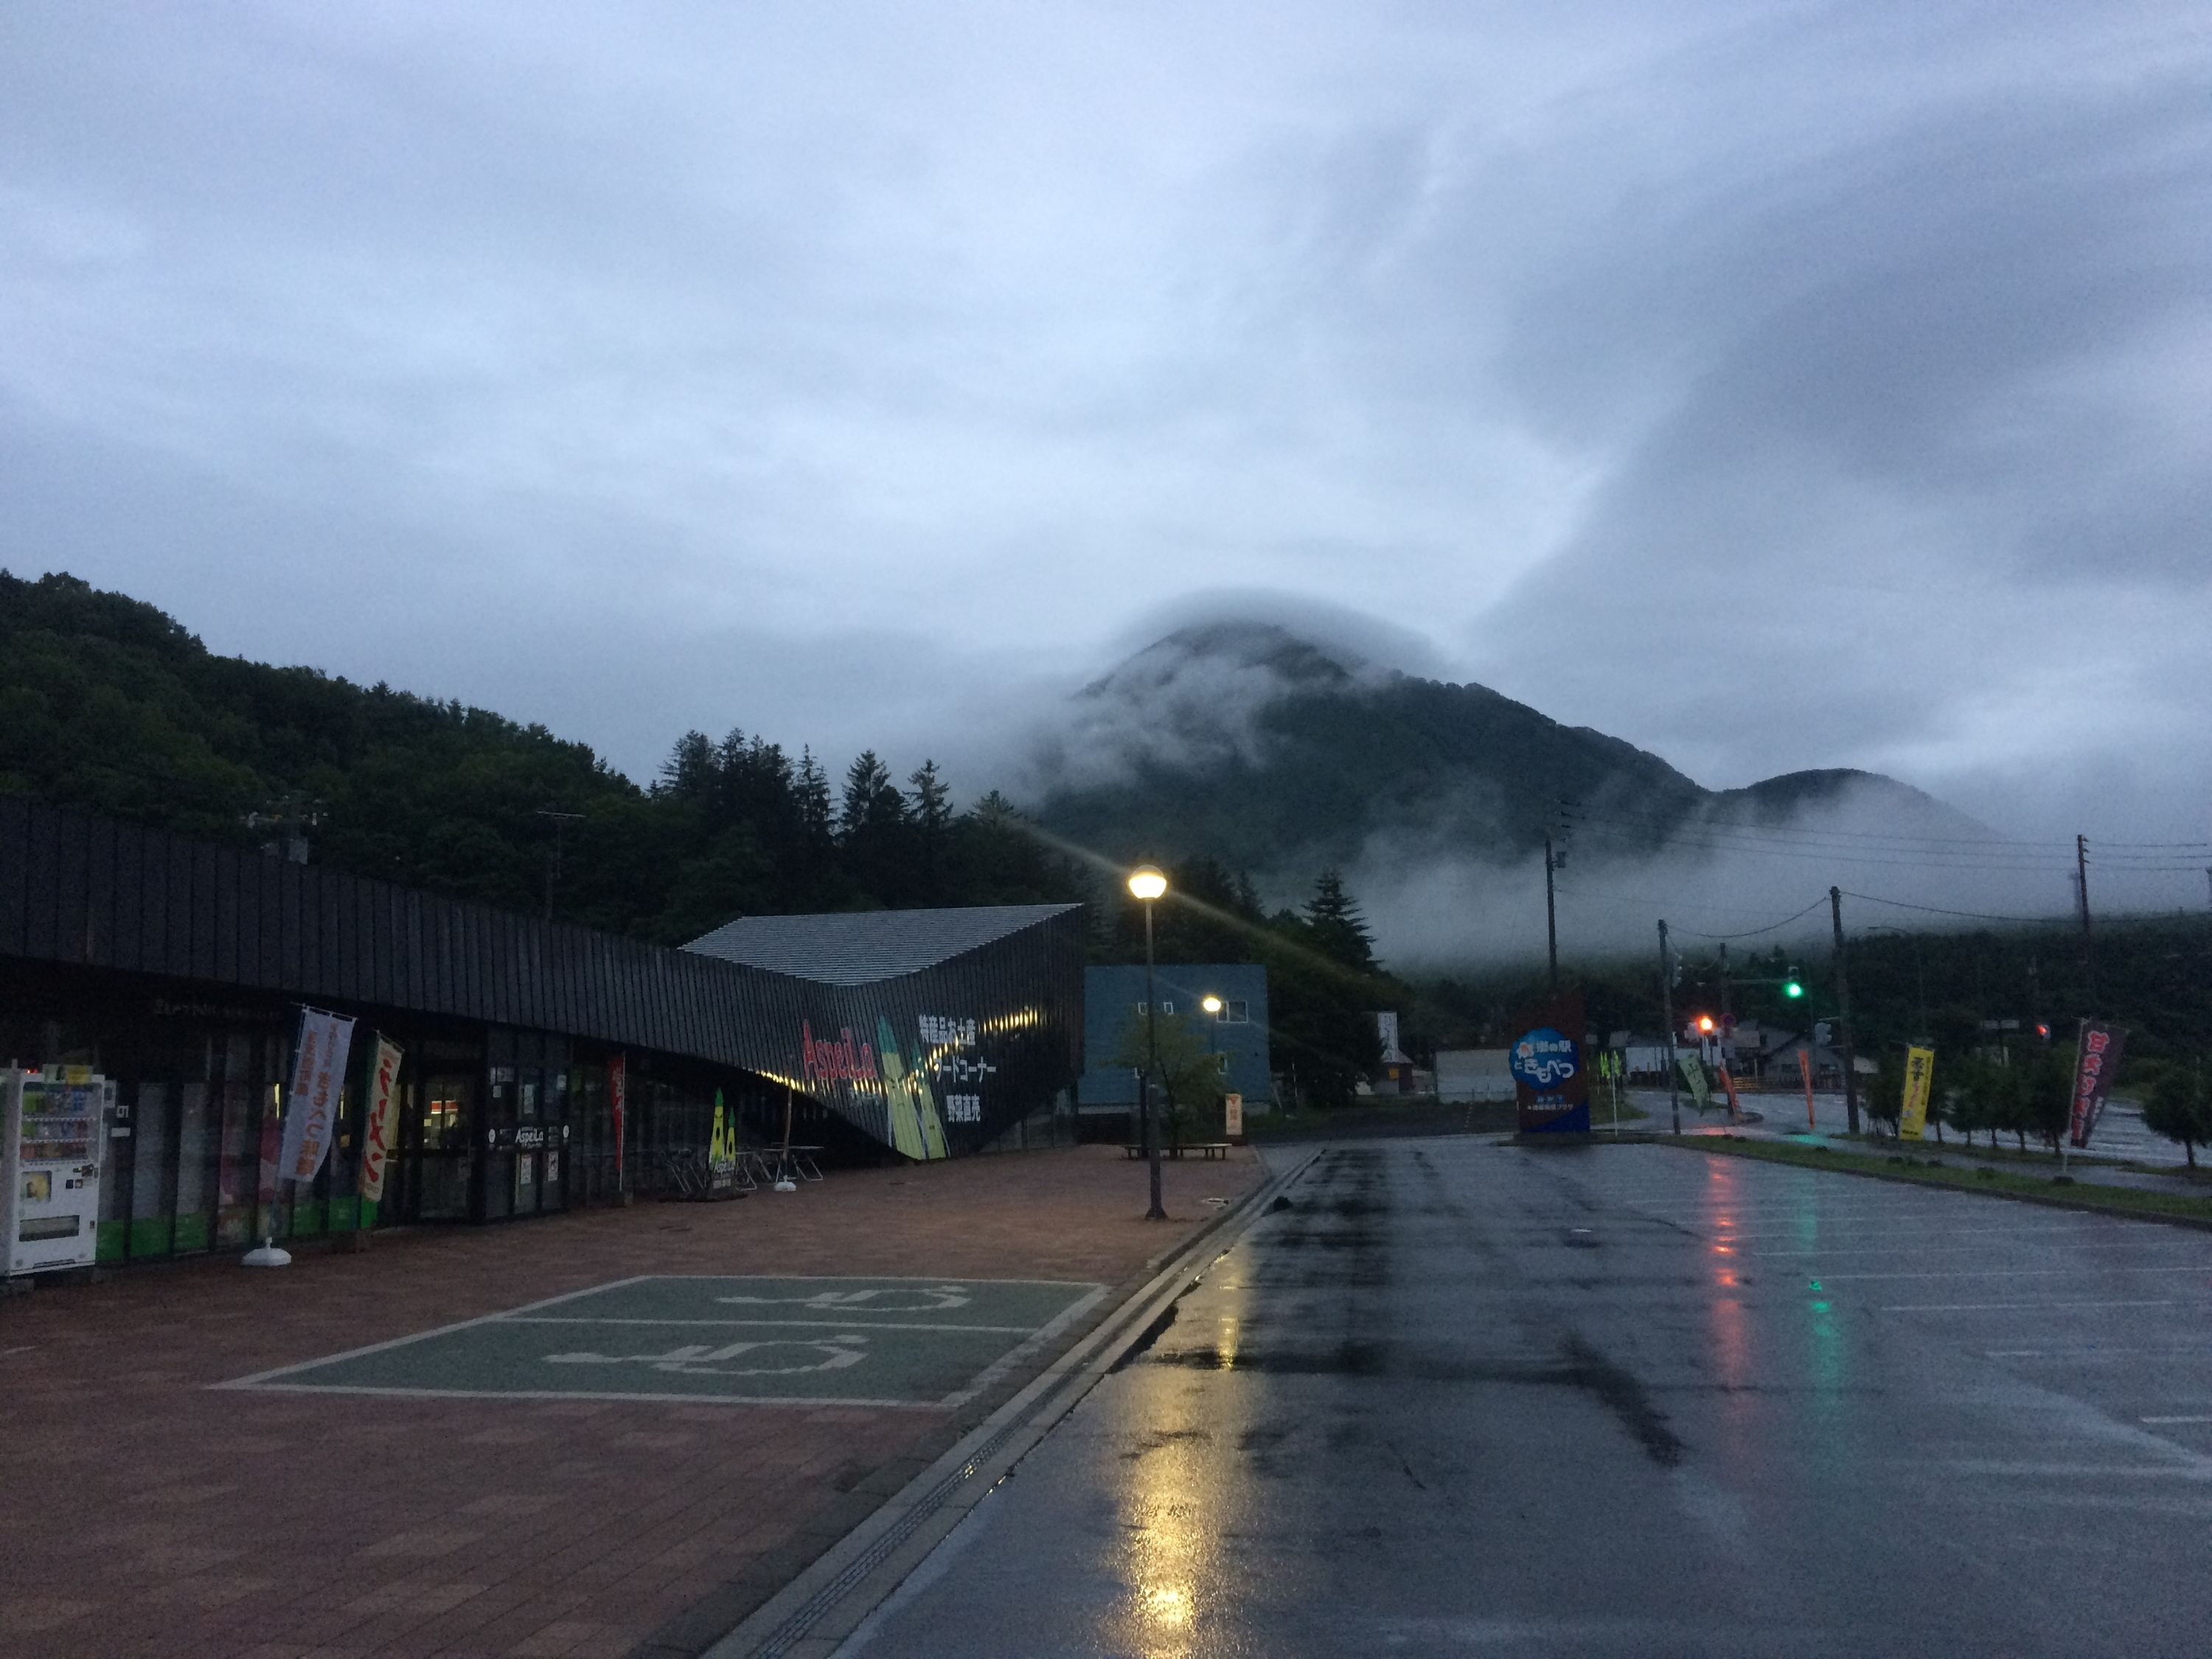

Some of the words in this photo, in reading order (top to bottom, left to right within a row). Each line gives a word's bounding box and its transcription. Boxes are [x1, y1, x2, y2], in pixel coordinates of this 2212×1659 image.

[919, 1015, 976, 1046] 特産品お土産
[802, 1018, 877, 1085] AspeiLa
[932, 1055, 997, 1083] フードコーナー
[946, 1094, 981, 1123] 野菜直売
